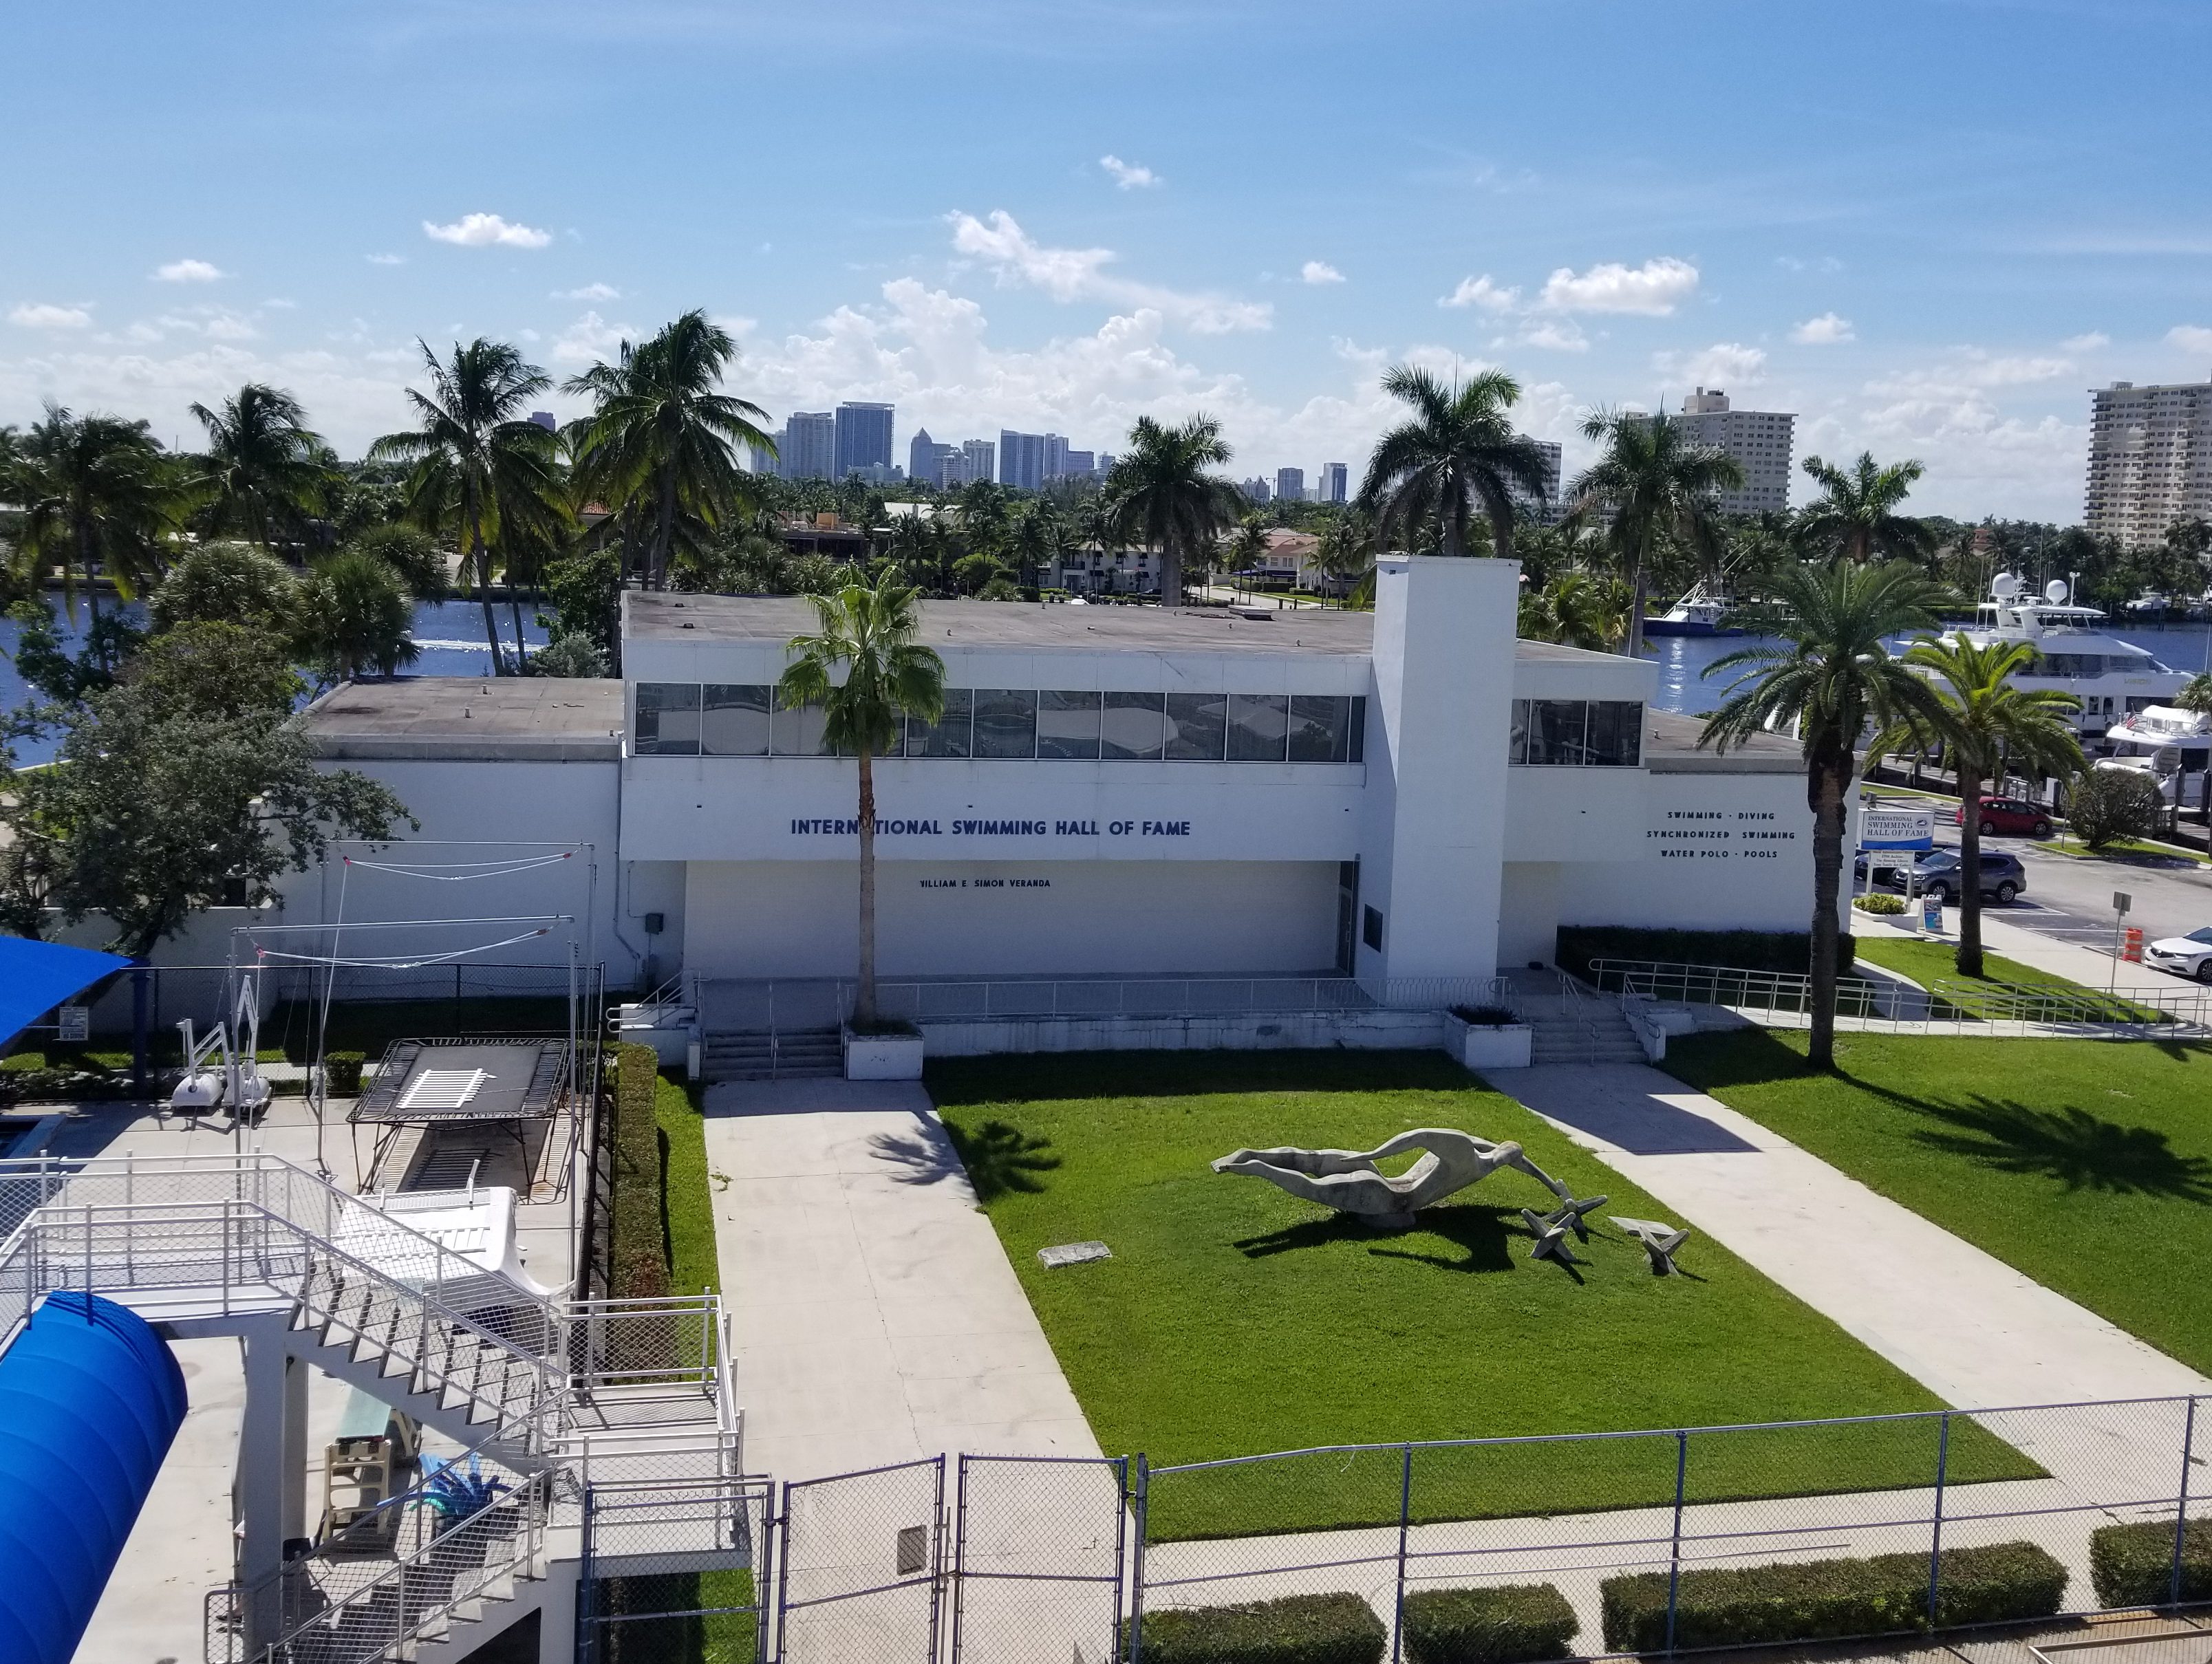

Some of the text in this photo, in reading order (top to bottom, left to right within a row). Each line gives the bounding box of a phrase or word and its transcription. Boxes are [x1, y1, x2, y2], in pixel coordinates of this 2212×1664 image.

[791, 819, 1190, 836] INTERNTIONAL SWIMMING HALL OF FAME
